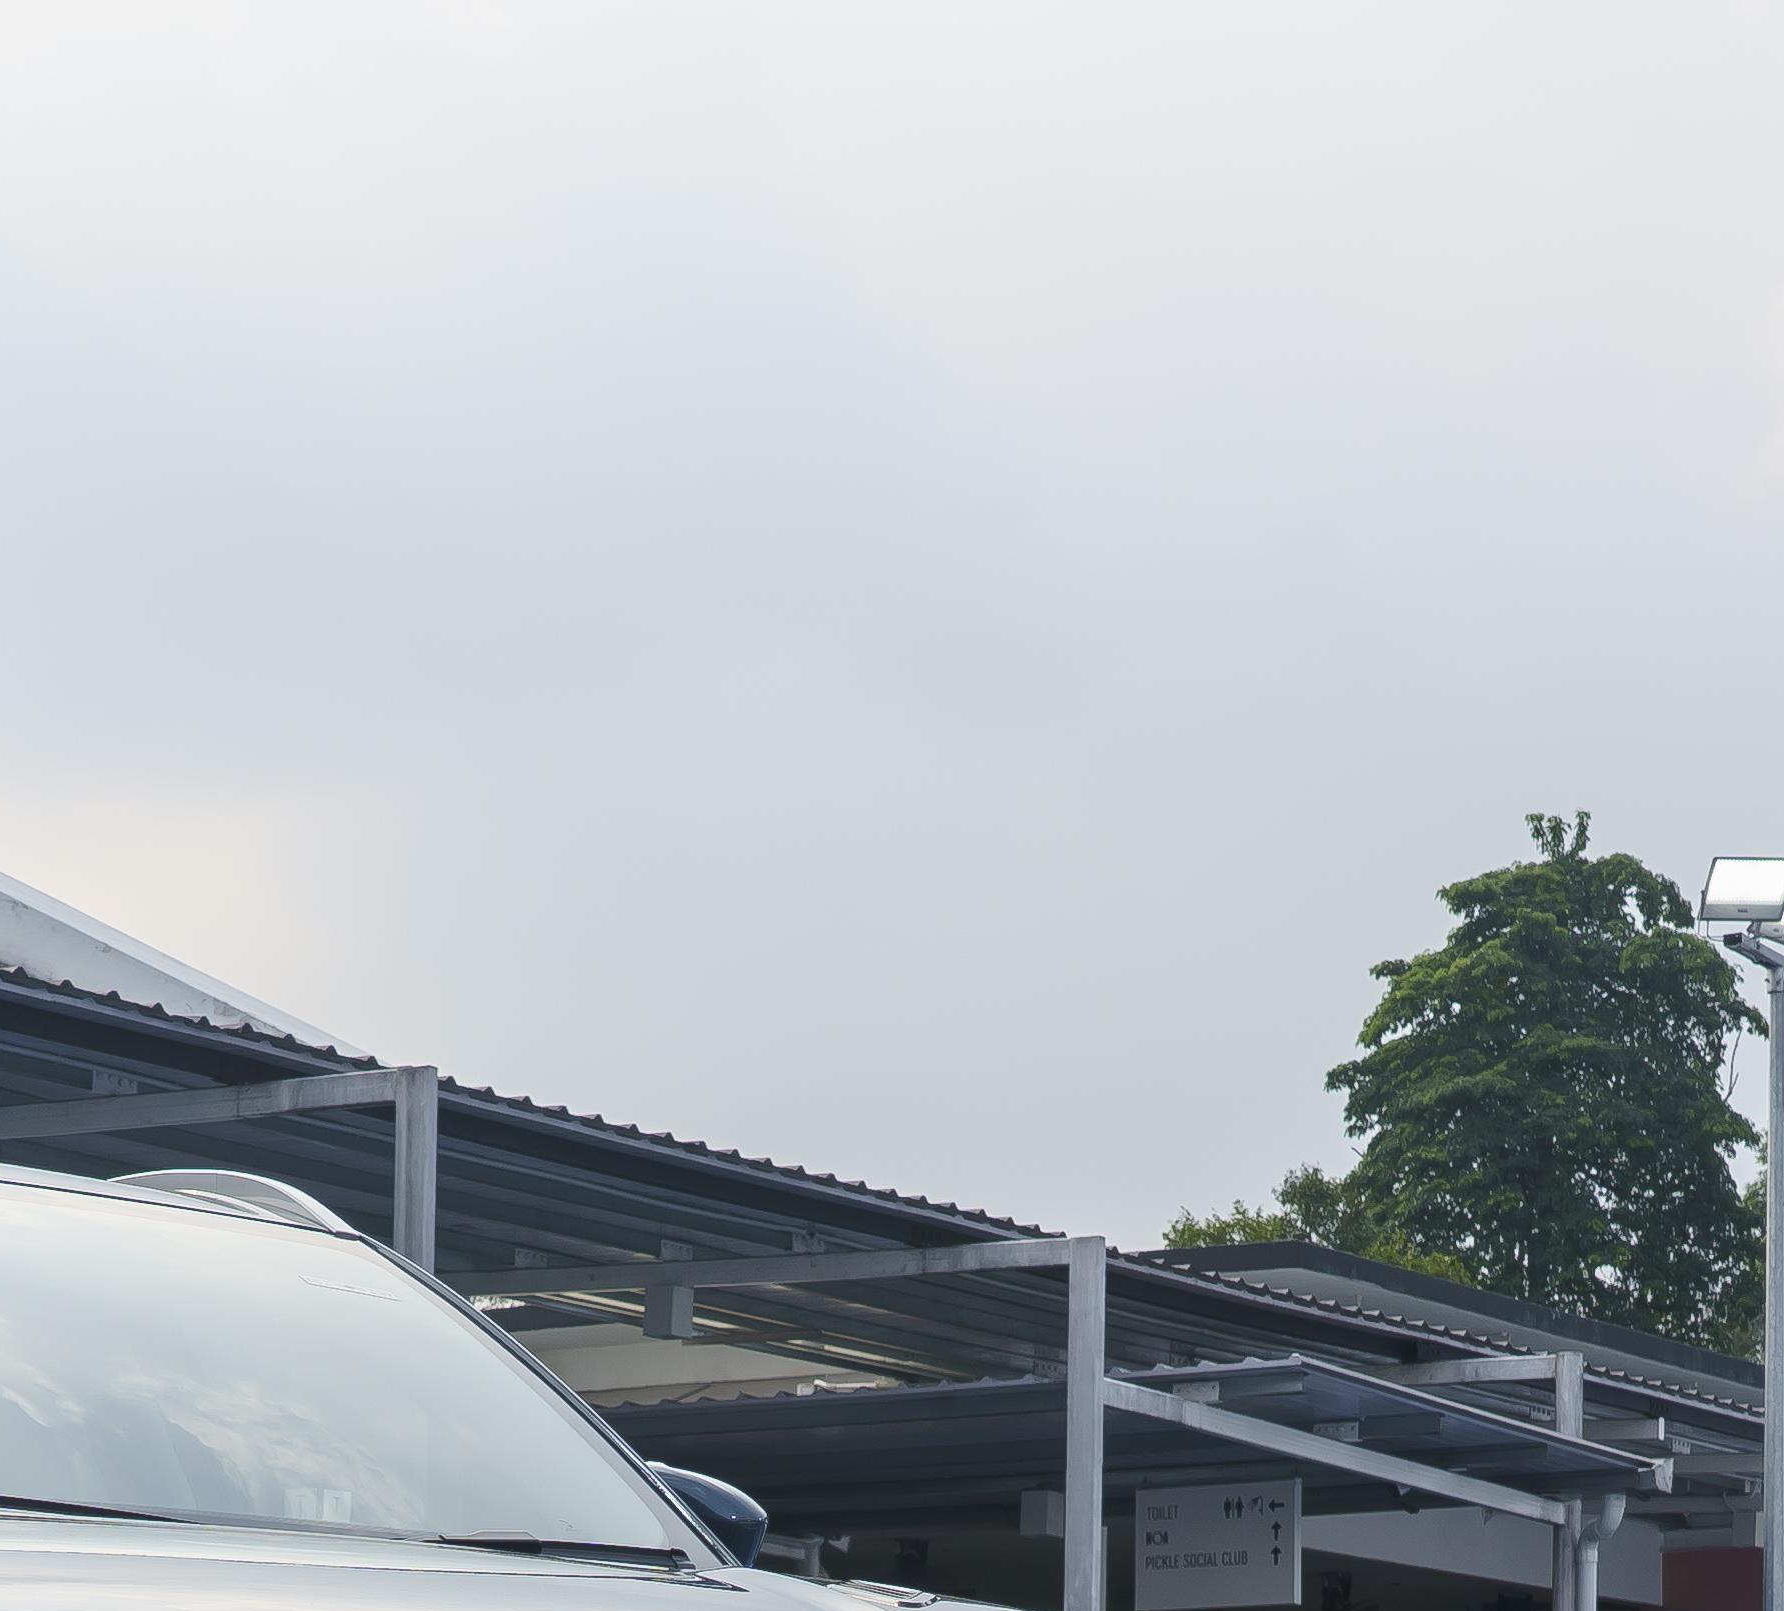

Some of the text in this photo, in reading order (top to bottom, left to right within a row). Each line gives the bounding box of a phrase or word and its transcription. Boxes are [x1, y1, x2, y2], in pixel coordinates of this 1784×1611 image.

[1146, 1504, 1179, 1522] TOILET
[1145, 1549, 1249, 1571] PICKLE SOCIAL CLUB
